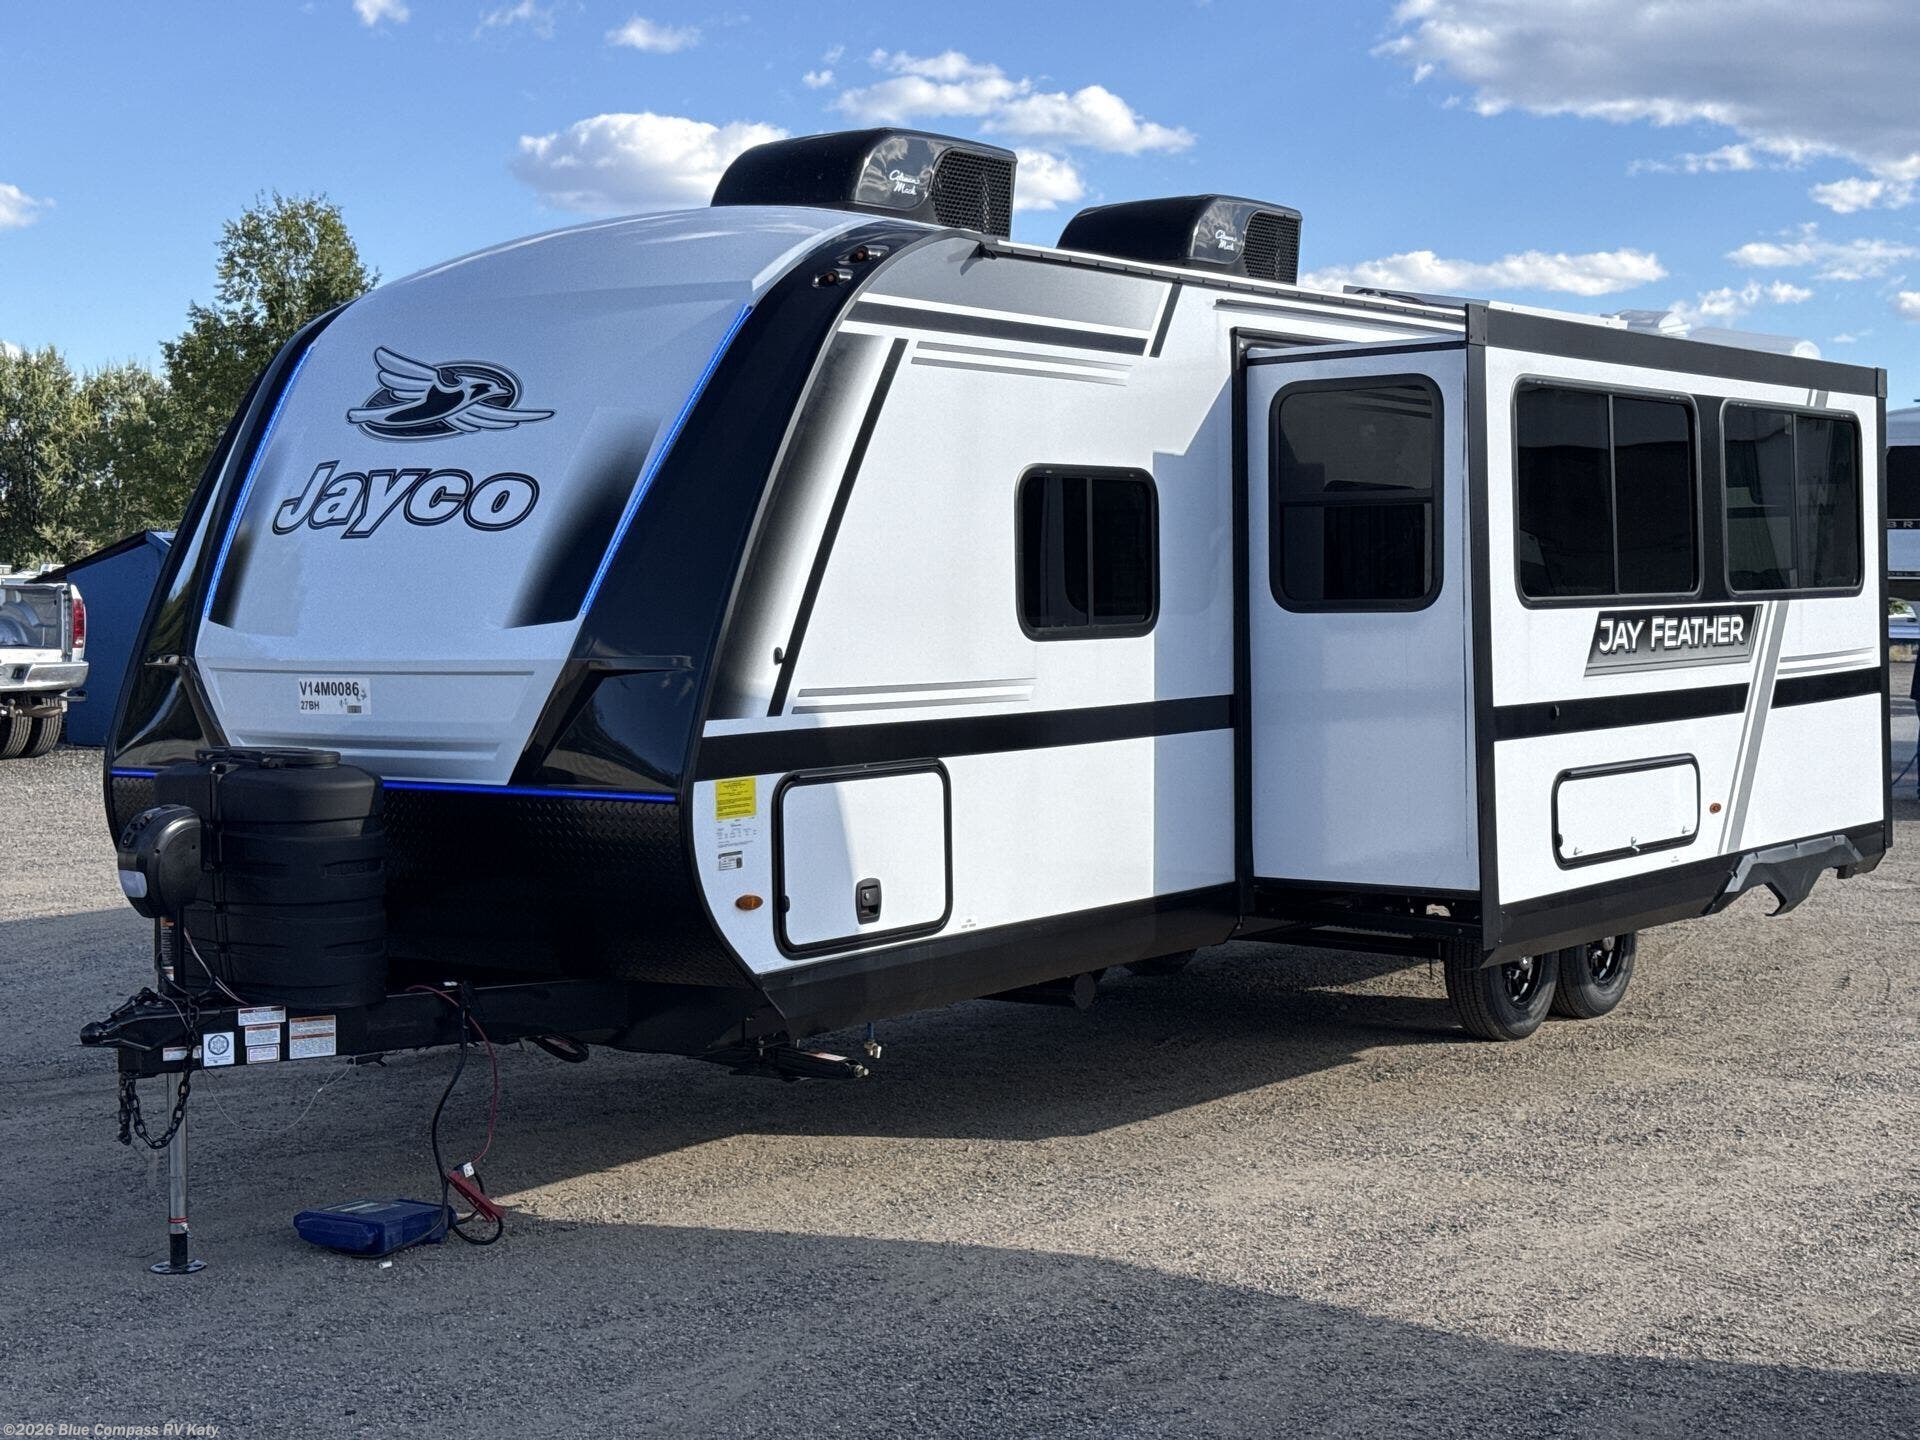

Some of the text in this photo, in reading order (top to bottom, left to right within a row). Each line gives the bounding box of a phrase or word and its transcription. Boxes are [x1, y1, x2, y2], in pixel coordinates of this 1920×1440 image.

[272, 460, 540, 539] Jayco
[1600, 614, 1745, 653] JAY FEATHER
[299, 681, 360, 697] V14M0086
[300, 700, 320, 711] 27BH
